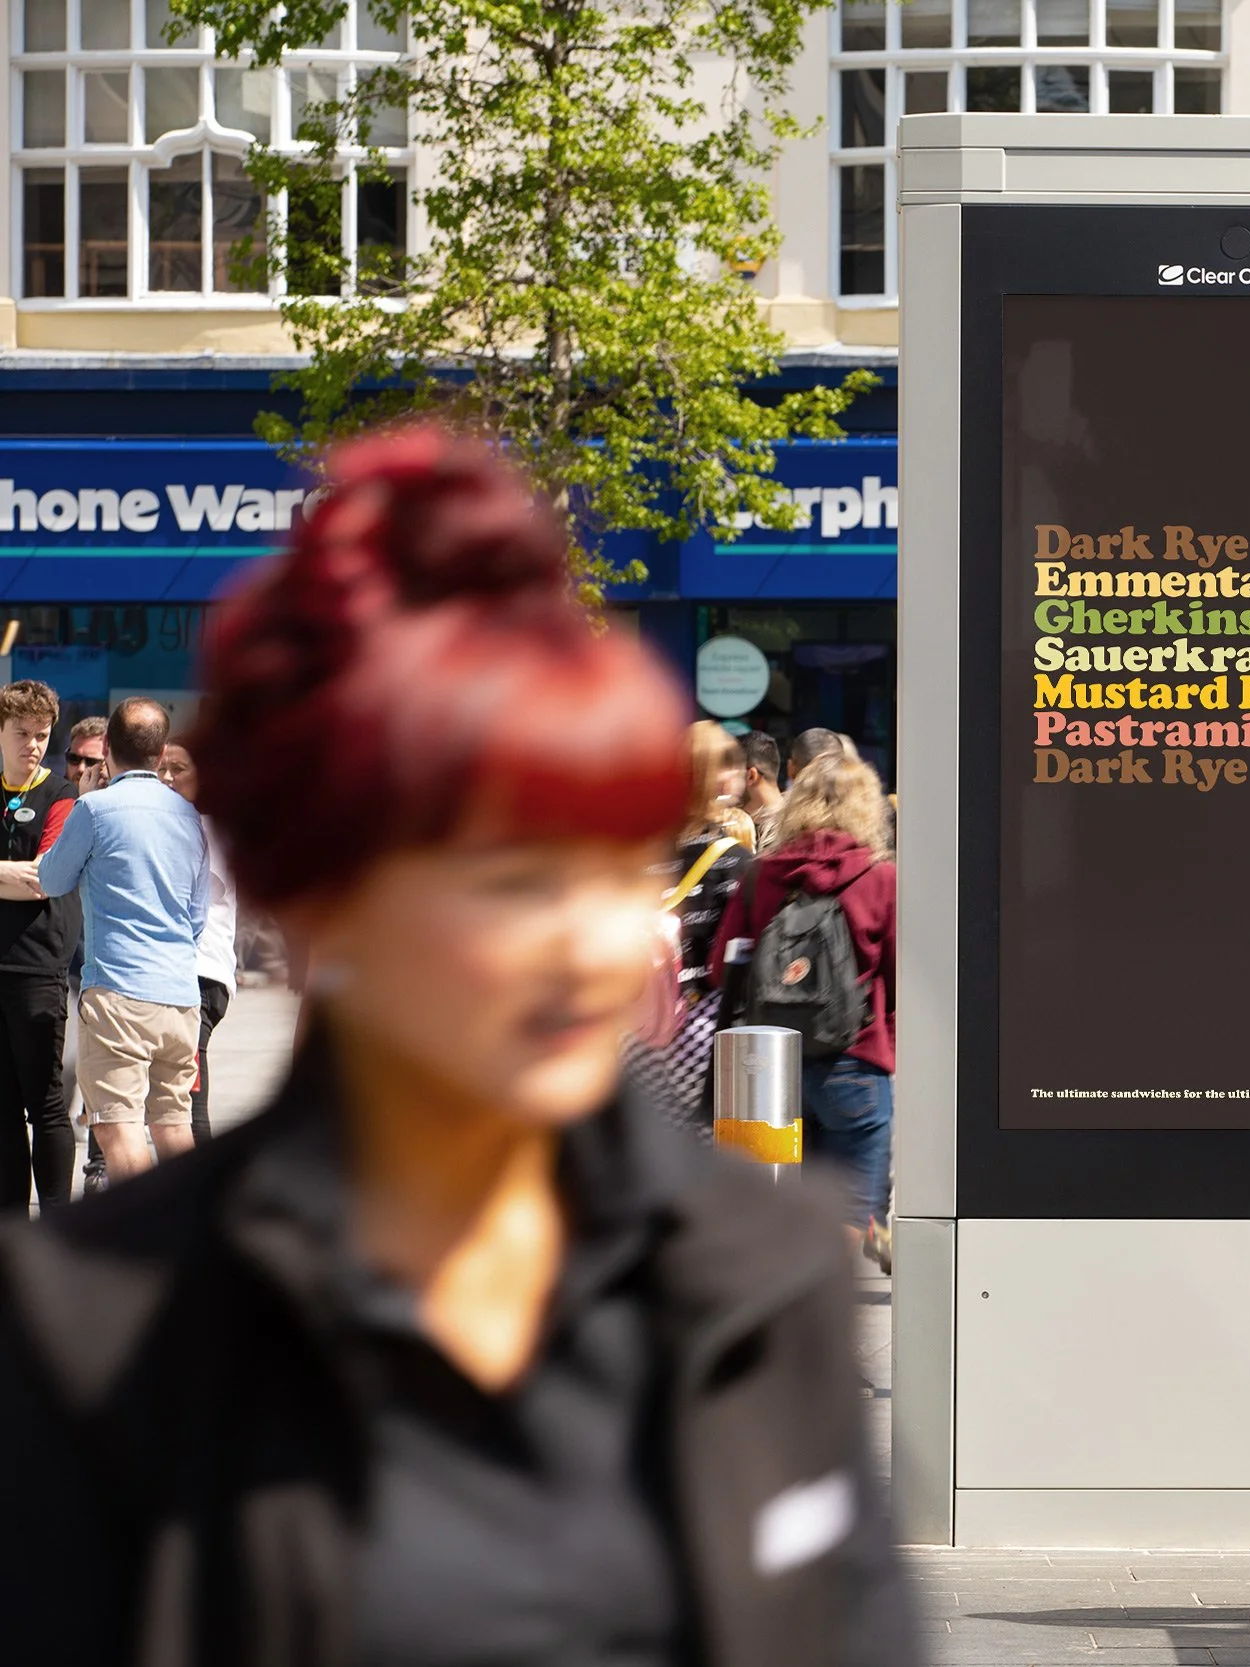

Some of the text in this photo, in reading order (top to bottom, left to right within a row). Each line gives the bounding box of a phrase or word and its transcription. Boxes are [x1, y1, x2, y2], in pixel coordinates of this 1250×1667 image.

[1186, 267, 1236, 285] Clear
[0, 478, 160, 532] hone
[1034, 524, 1154, 561] Dark
[1163, 525, 1249, 568] Rye
[1033, 673, 1230, 709] Mustard
[1033, 748, 1153, 784] Dark
[1161, 749, 1248, 792] Rye
[1030, 1088, 1054, 1098] The
[1056, 1088, 1109, 1098] ultimate
[1110, 1089, 1182, 1099] sandwiches
[1183, 1089, 1203, 1099] for
[1204, 1089, 1226, 1099] the
